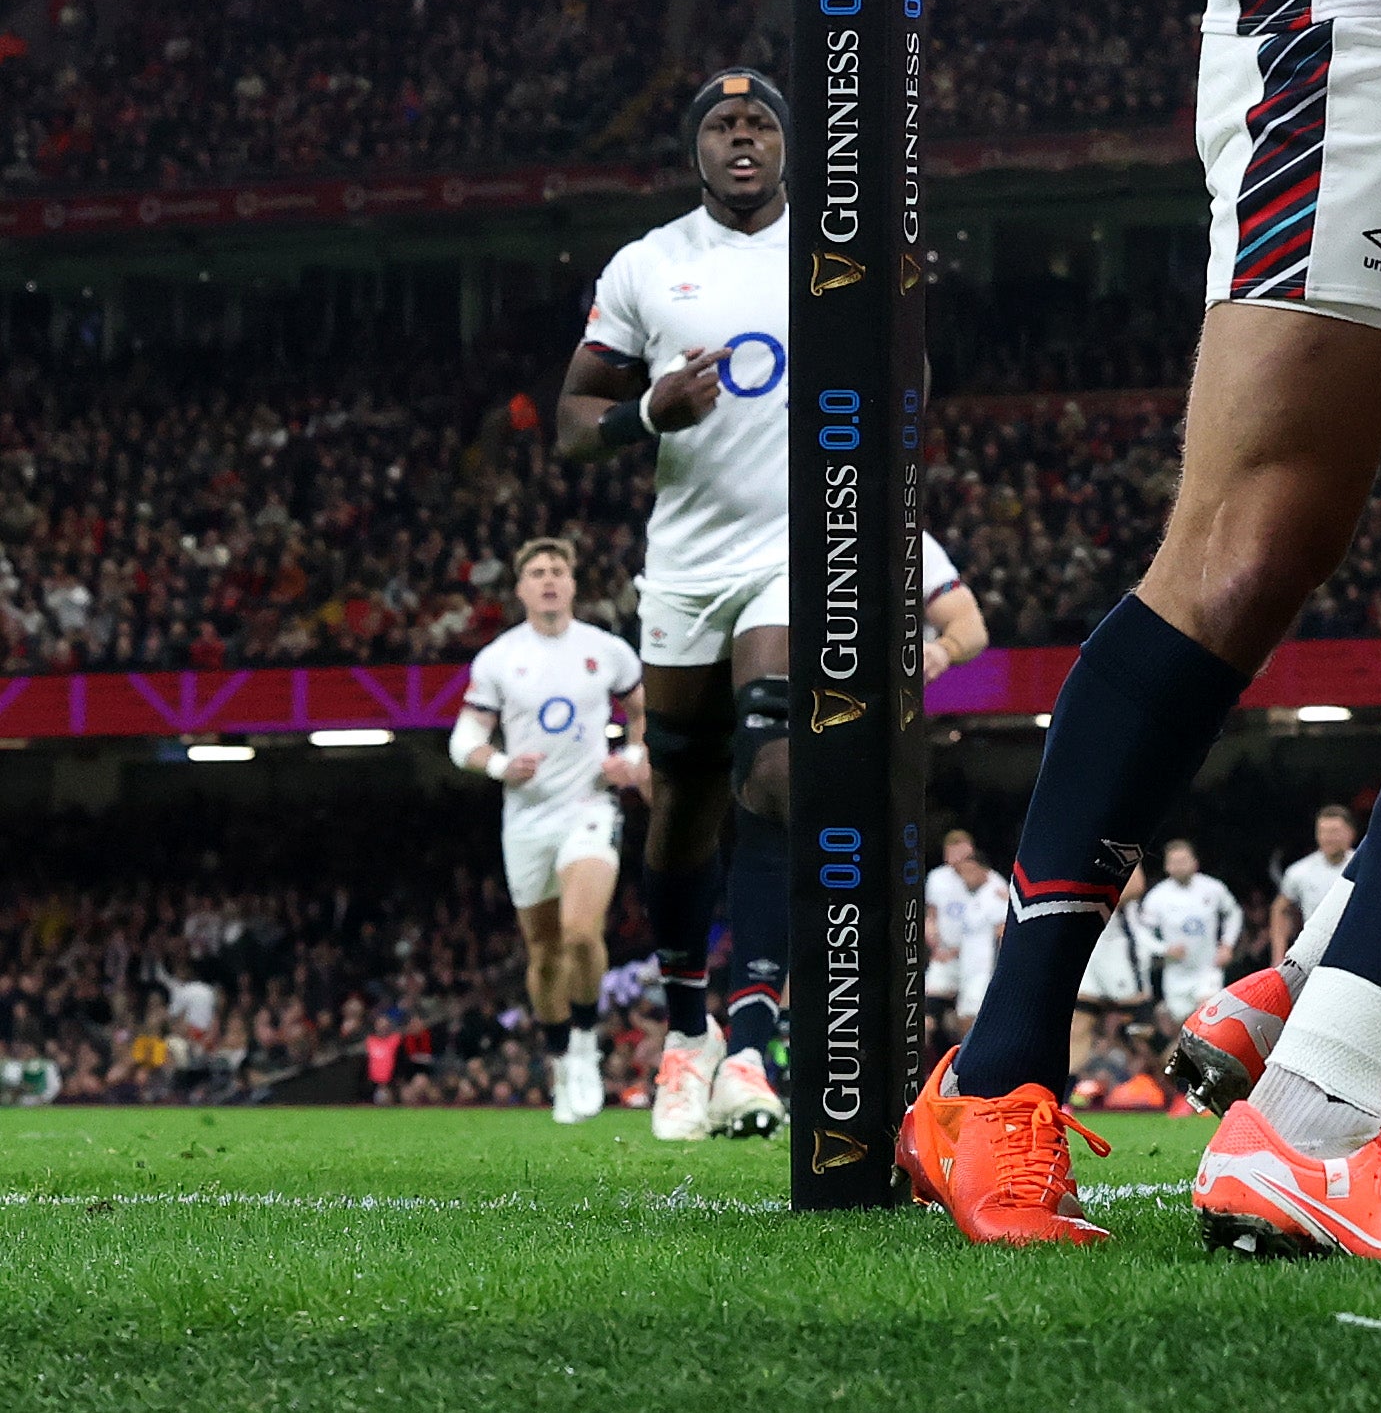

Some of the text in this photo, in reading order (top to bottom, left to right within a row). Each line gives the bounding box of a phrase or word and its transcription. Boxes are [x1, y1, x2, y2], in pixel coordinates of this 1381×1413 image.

[821, 29, 860, 243] GUINNESS
[903, 32, 920, 244] GUINNESS
[819, 390, 861, 680] GUINNESS 0.0
[902, 463, 919, 678] GUINNESS
[819, 828, 862, 1121] GUINNESS 0.0
[904, 898, 920, 1108] GUINNESS
